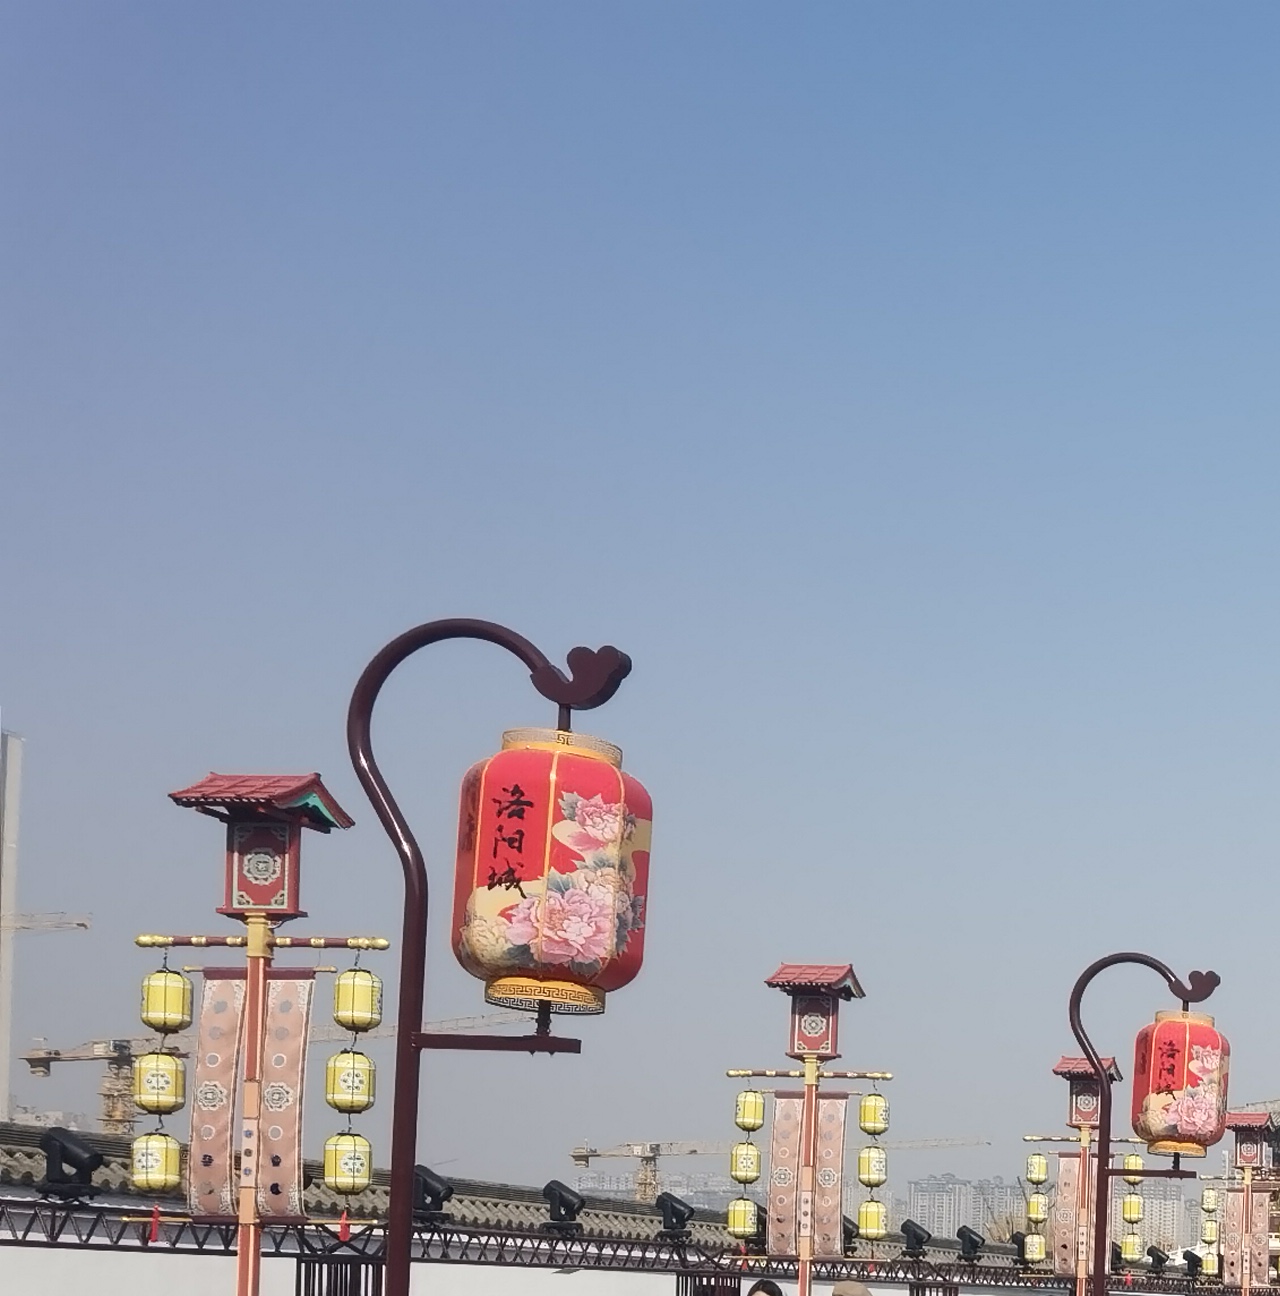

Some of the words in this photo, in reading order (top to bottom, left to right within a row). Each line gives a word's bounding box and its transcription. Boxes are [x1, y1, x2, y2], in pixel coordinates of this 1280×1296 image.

[487, 783, 534, 899] 洛阳城
[1156, 1039, 1181, 1101] 洛阳城
